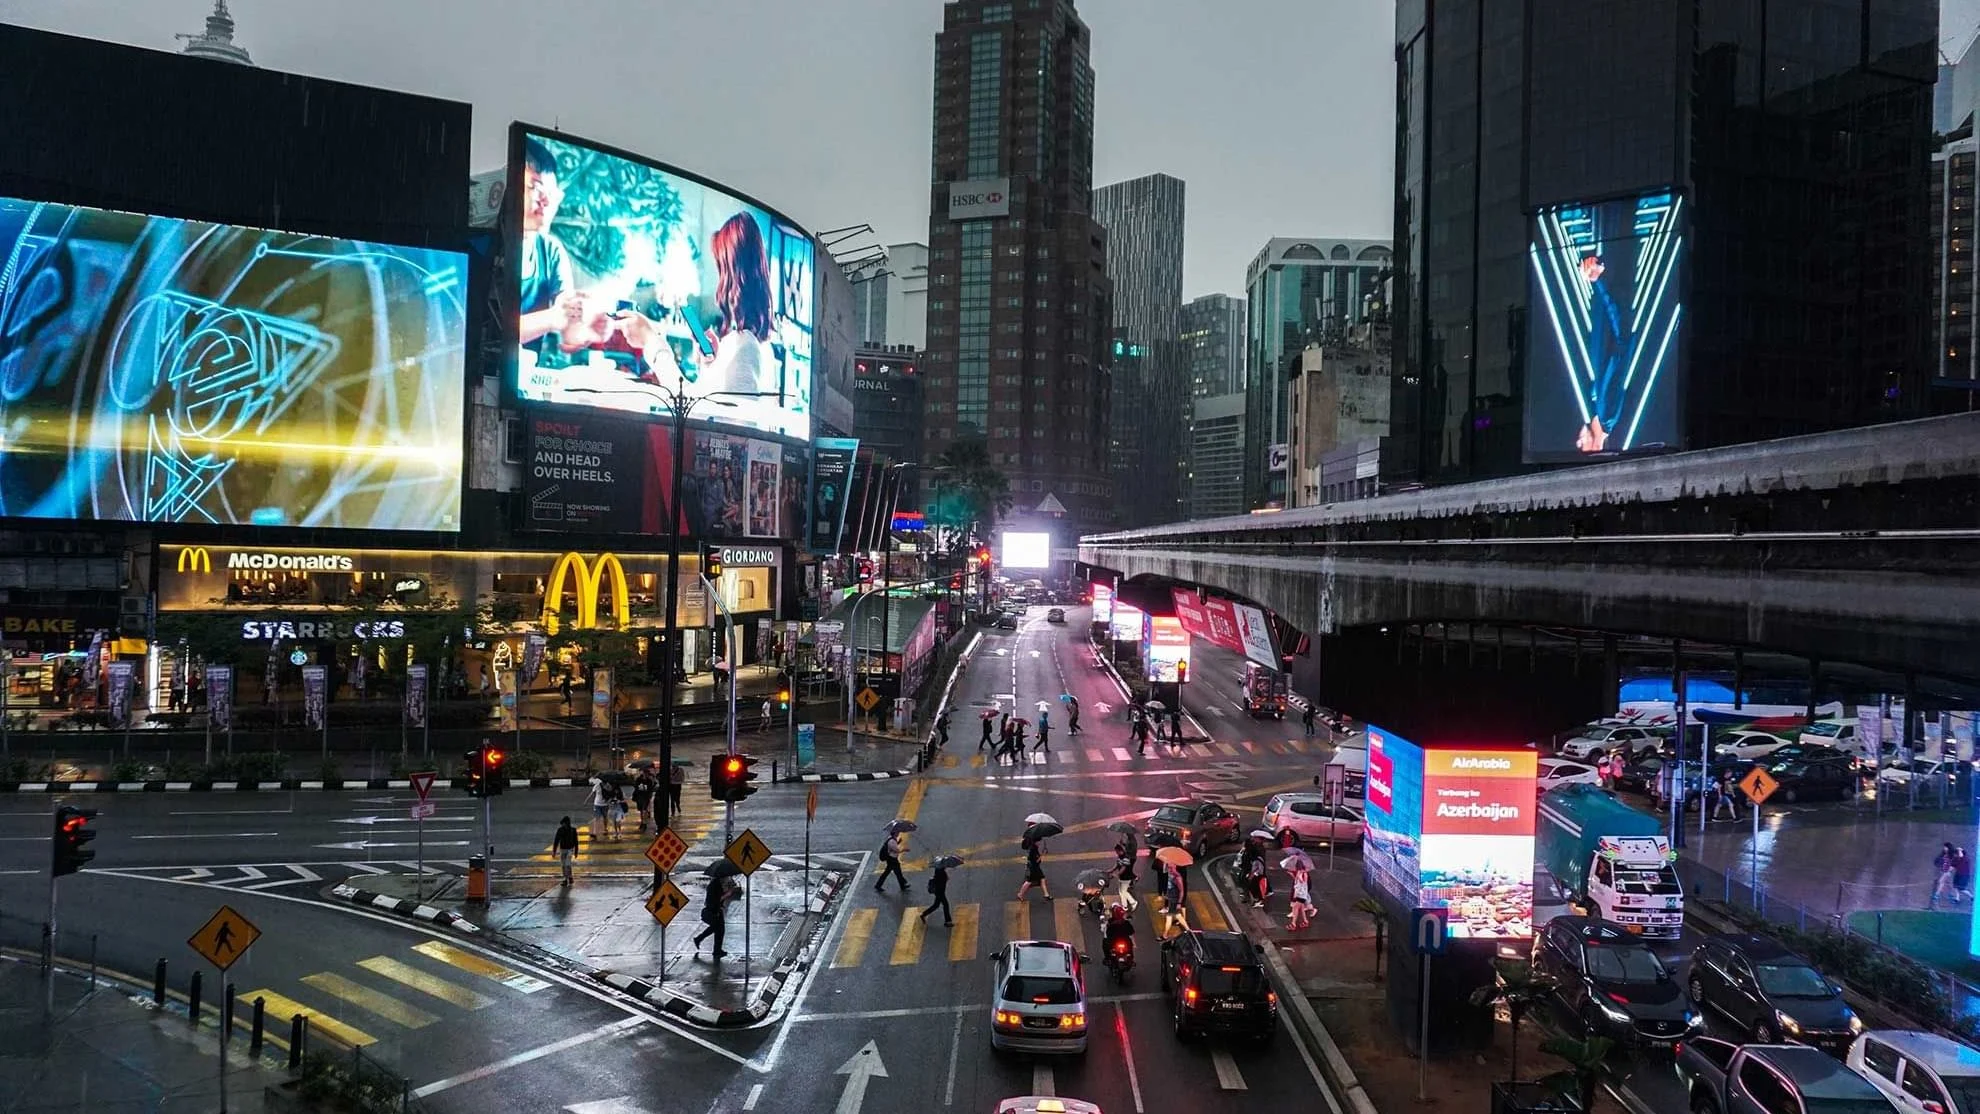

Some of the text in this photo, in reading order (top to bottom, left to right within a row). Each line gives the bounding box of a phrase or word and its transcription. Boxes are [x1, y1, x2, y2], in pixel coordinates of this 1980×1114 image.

[952, 194, 985, 206] HSBC
[535, 420, 582, 436] SPOILT
[535, 435, 613, 454] FOR CHOICE
[535, 451, 601, 467] AND HEAD
[534, 465, 615, 483] OVER HEELS.
[227, 552, 353, 570] McDonald's
[723, 549, 774, 564] GIORDANO
[4, 617, 76, 633] BAKE
[242, 620, 405, 639] STARBUCKS
[1436, 802, 1519, 821] Azerbaijan
